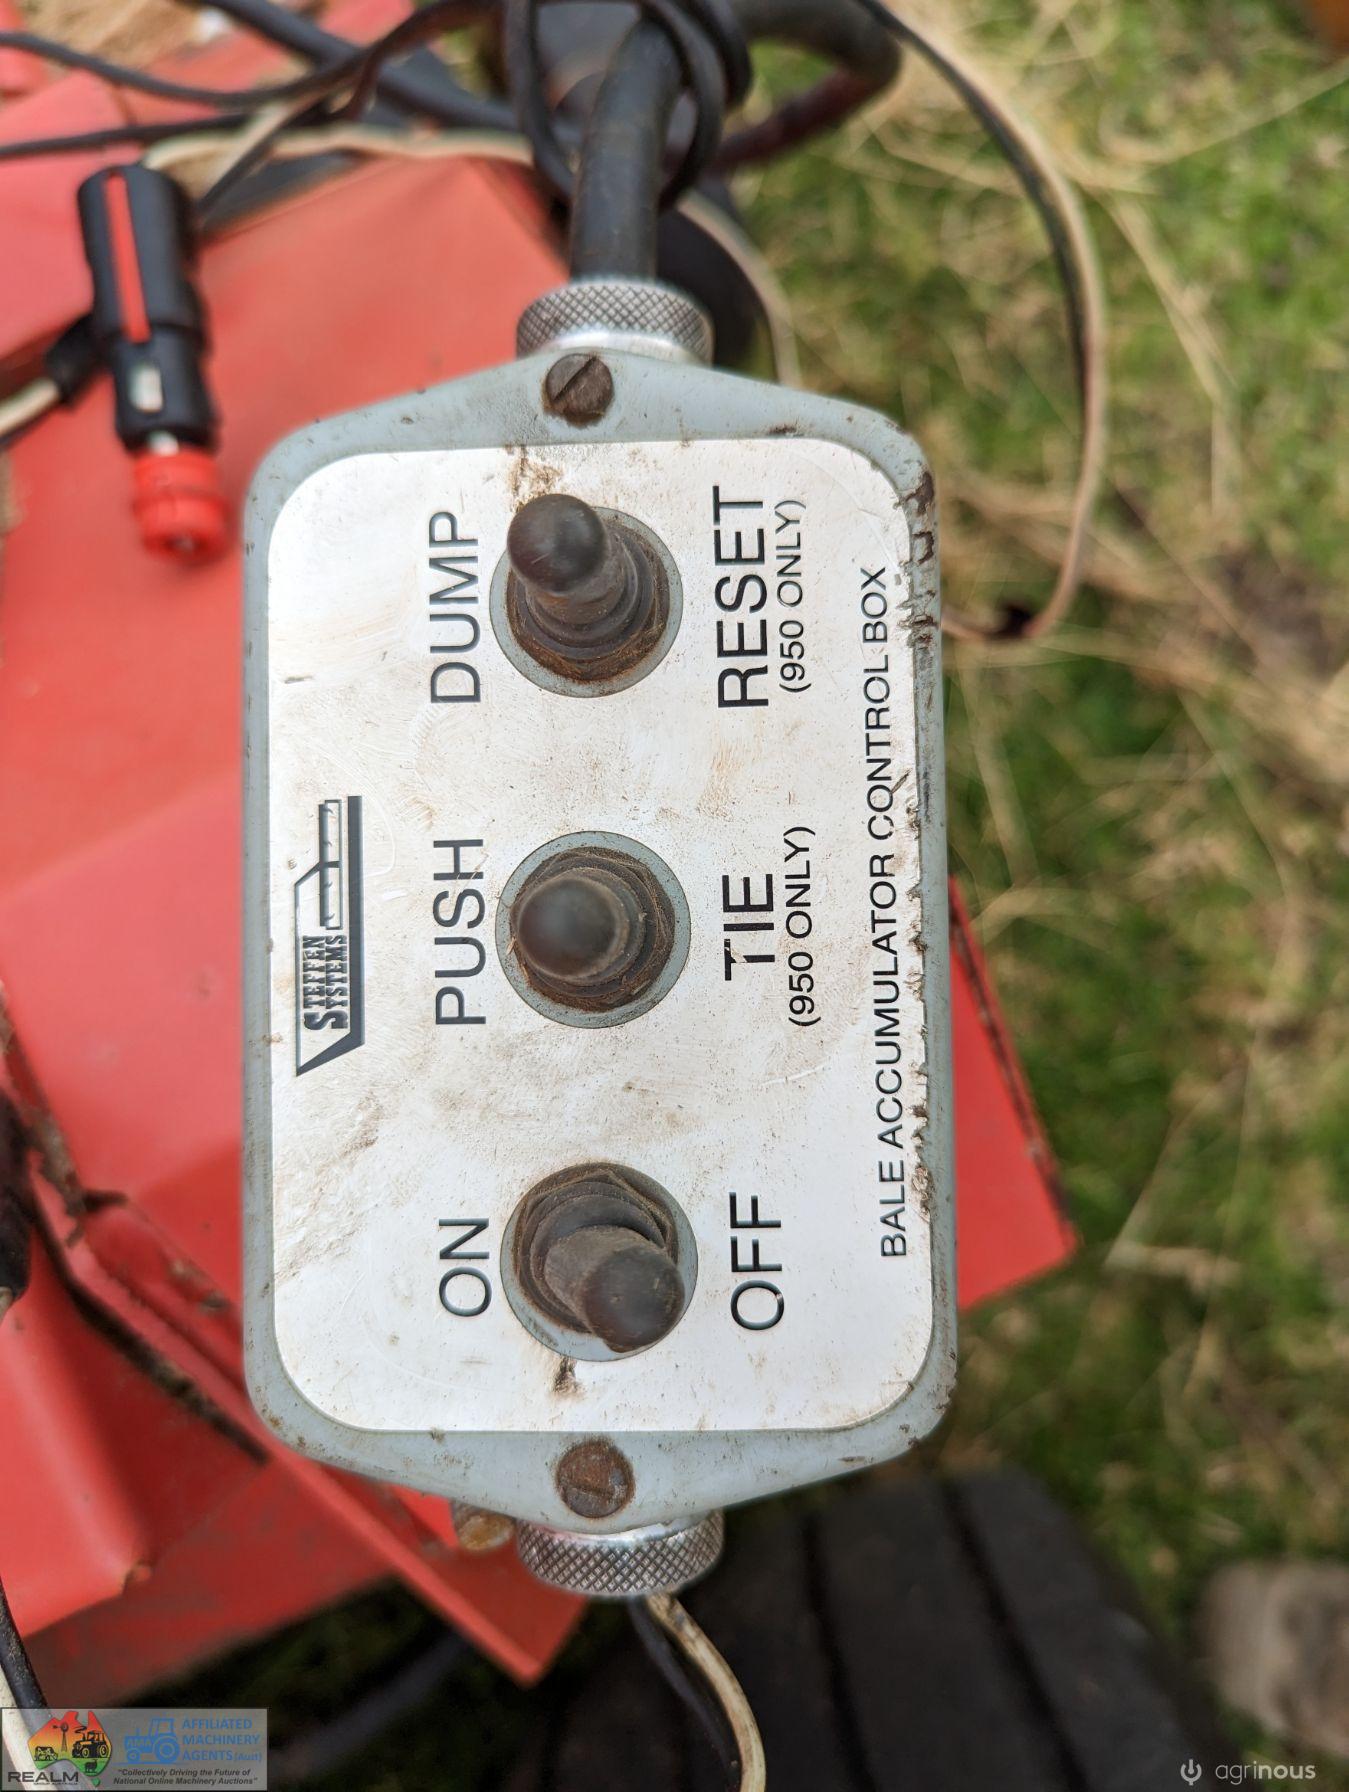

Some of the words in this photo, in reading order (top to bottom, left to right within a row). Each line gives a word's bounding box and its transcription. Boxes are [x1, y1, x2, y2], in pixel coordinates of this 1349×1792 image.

[428, 511, 482, 704] DUMP
[712, 485, 769, 708] RESET
[774, 500, 807, 608] ONLY)
[860, 566, 888, 643] BOX
[779, 620, 812, 693] (950
[863, 654, 895, 841] CONTROL
[433, 838, 486, 1025] PUSH
[722, 873, 775, 981] TIE
[783, 826, 816, 939] ONLY)
[788, 951, 821, 1027] (950
[870, 853, 904, 1149] ACCUMULATOR
[729, 1191, 785, 1331] OFF
[878, 1160, 907, 1257] BALE
[438, 1217, 492, 1318] ON
